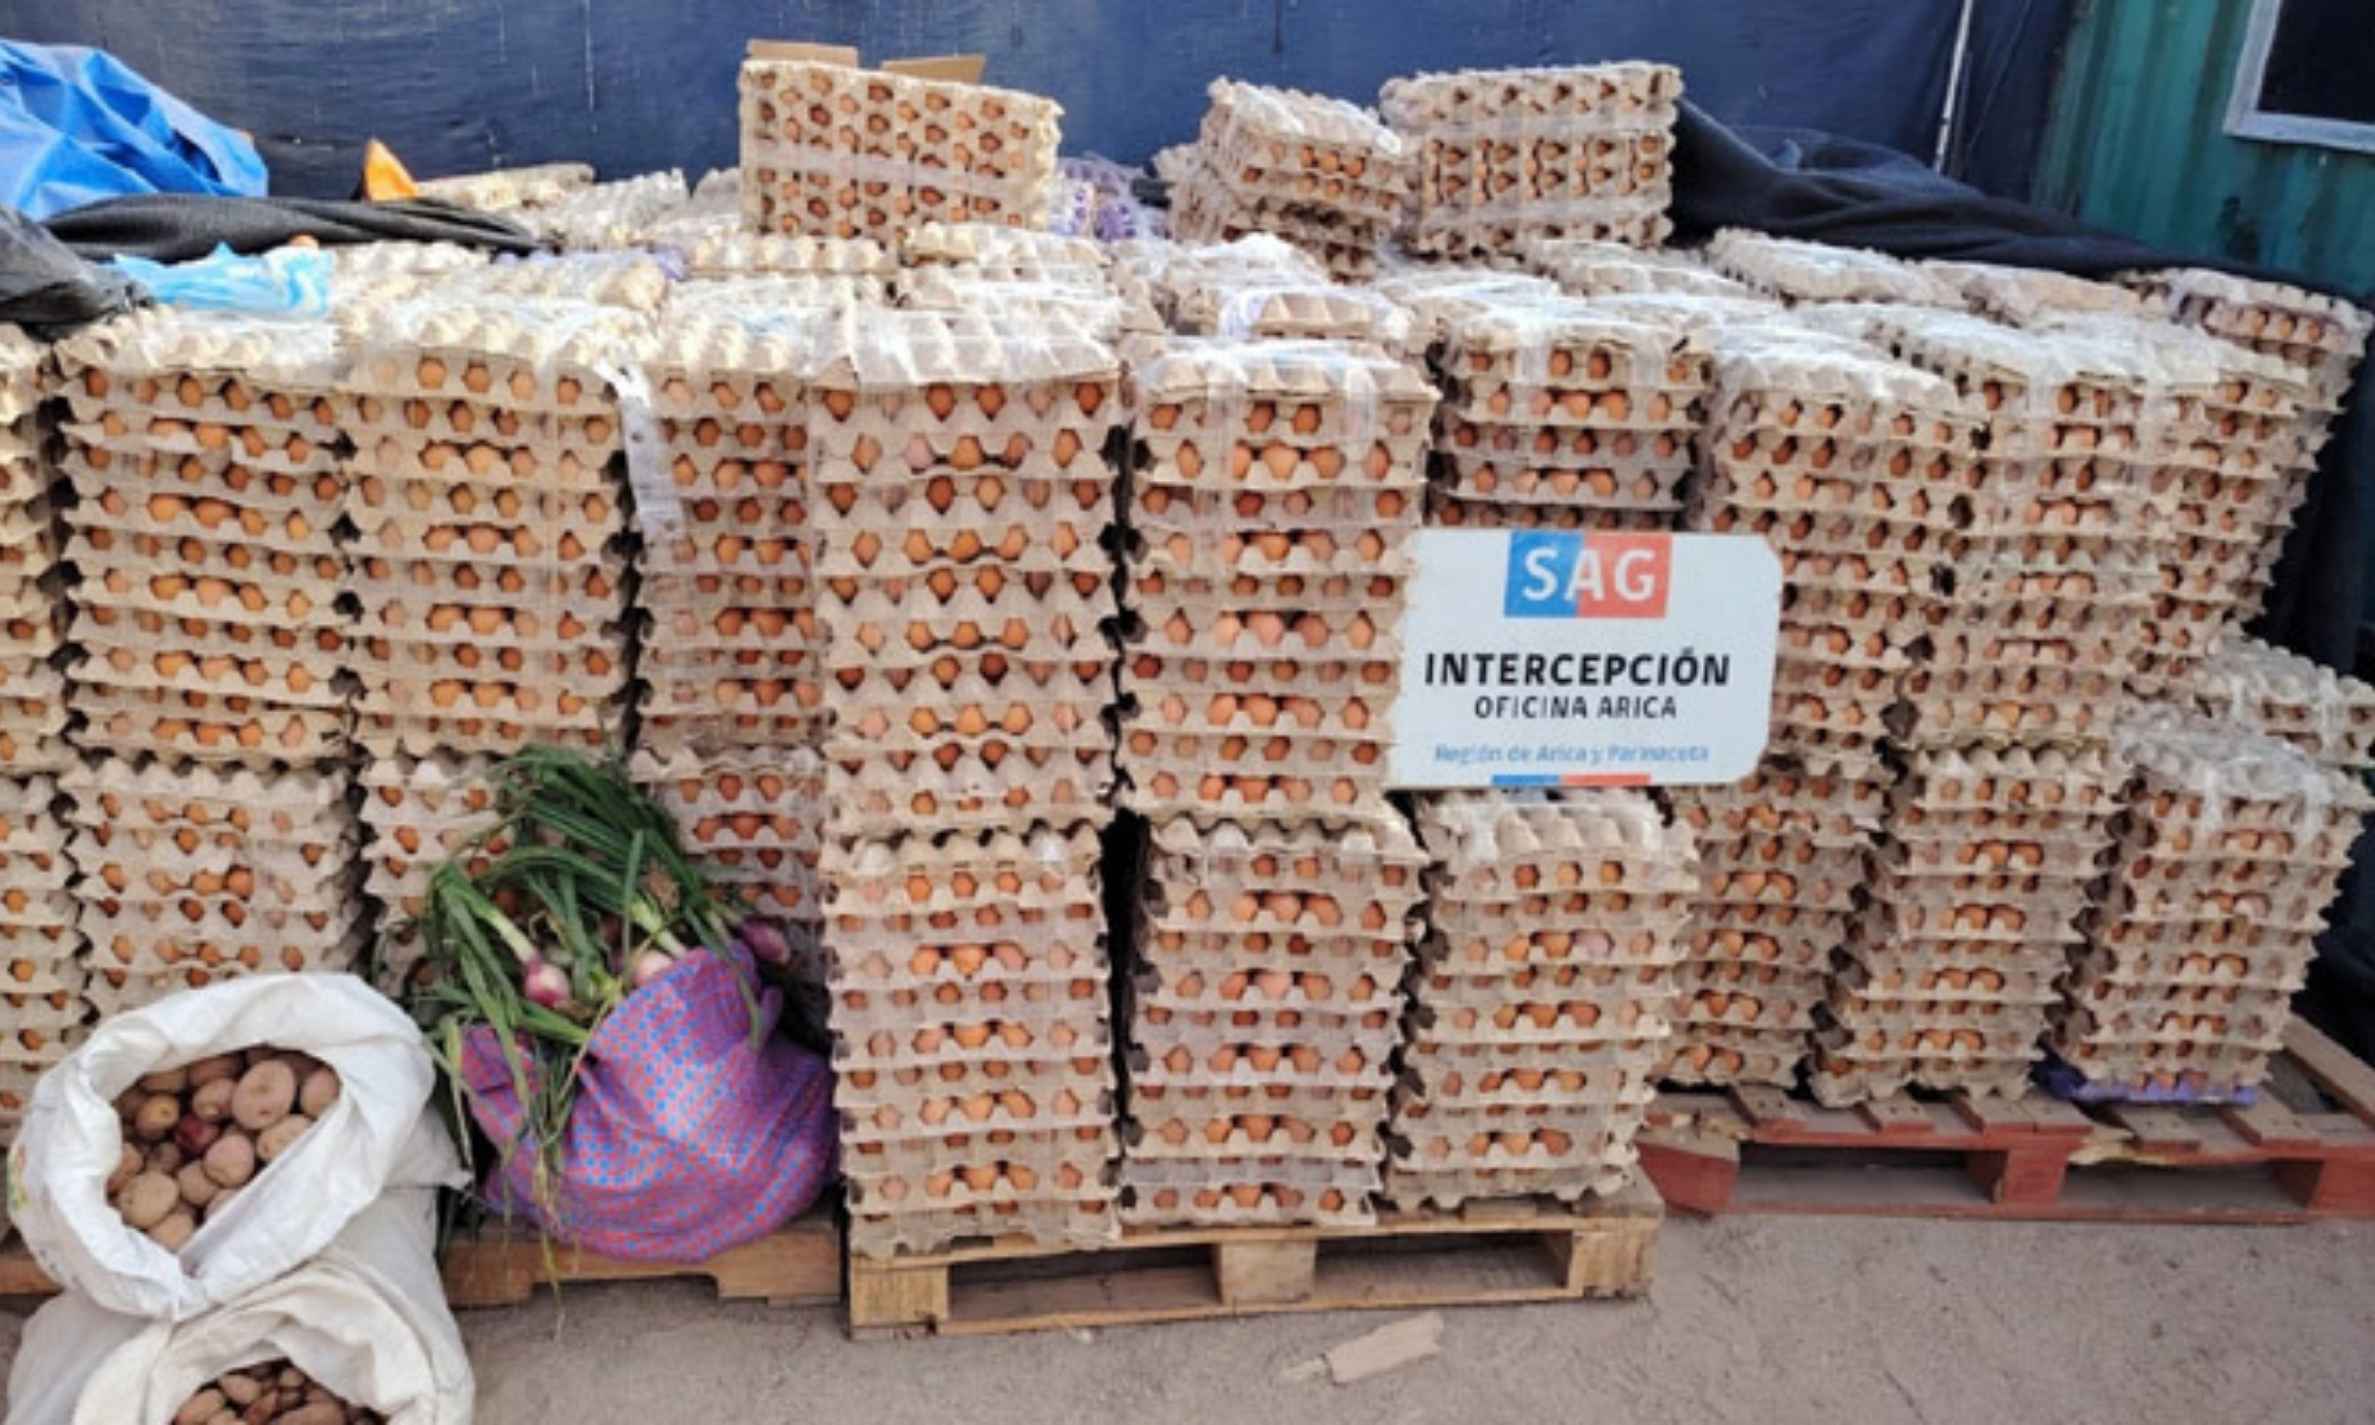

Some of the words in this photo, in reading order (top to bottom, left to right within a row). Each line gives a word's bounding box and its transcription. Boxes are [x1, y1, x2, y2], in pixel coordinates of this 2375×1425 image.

[1522, 547, 1655, 601] SAG
[1424, 648, 1731, 686] INTERCEPCIÓN
[1475, 696, 1587, 718] OFICINA
[1597, 696, 1677, 718] ARICA
[1507, 744, 1530, 760] de
[1537, 744, 1586, 760] Arica
